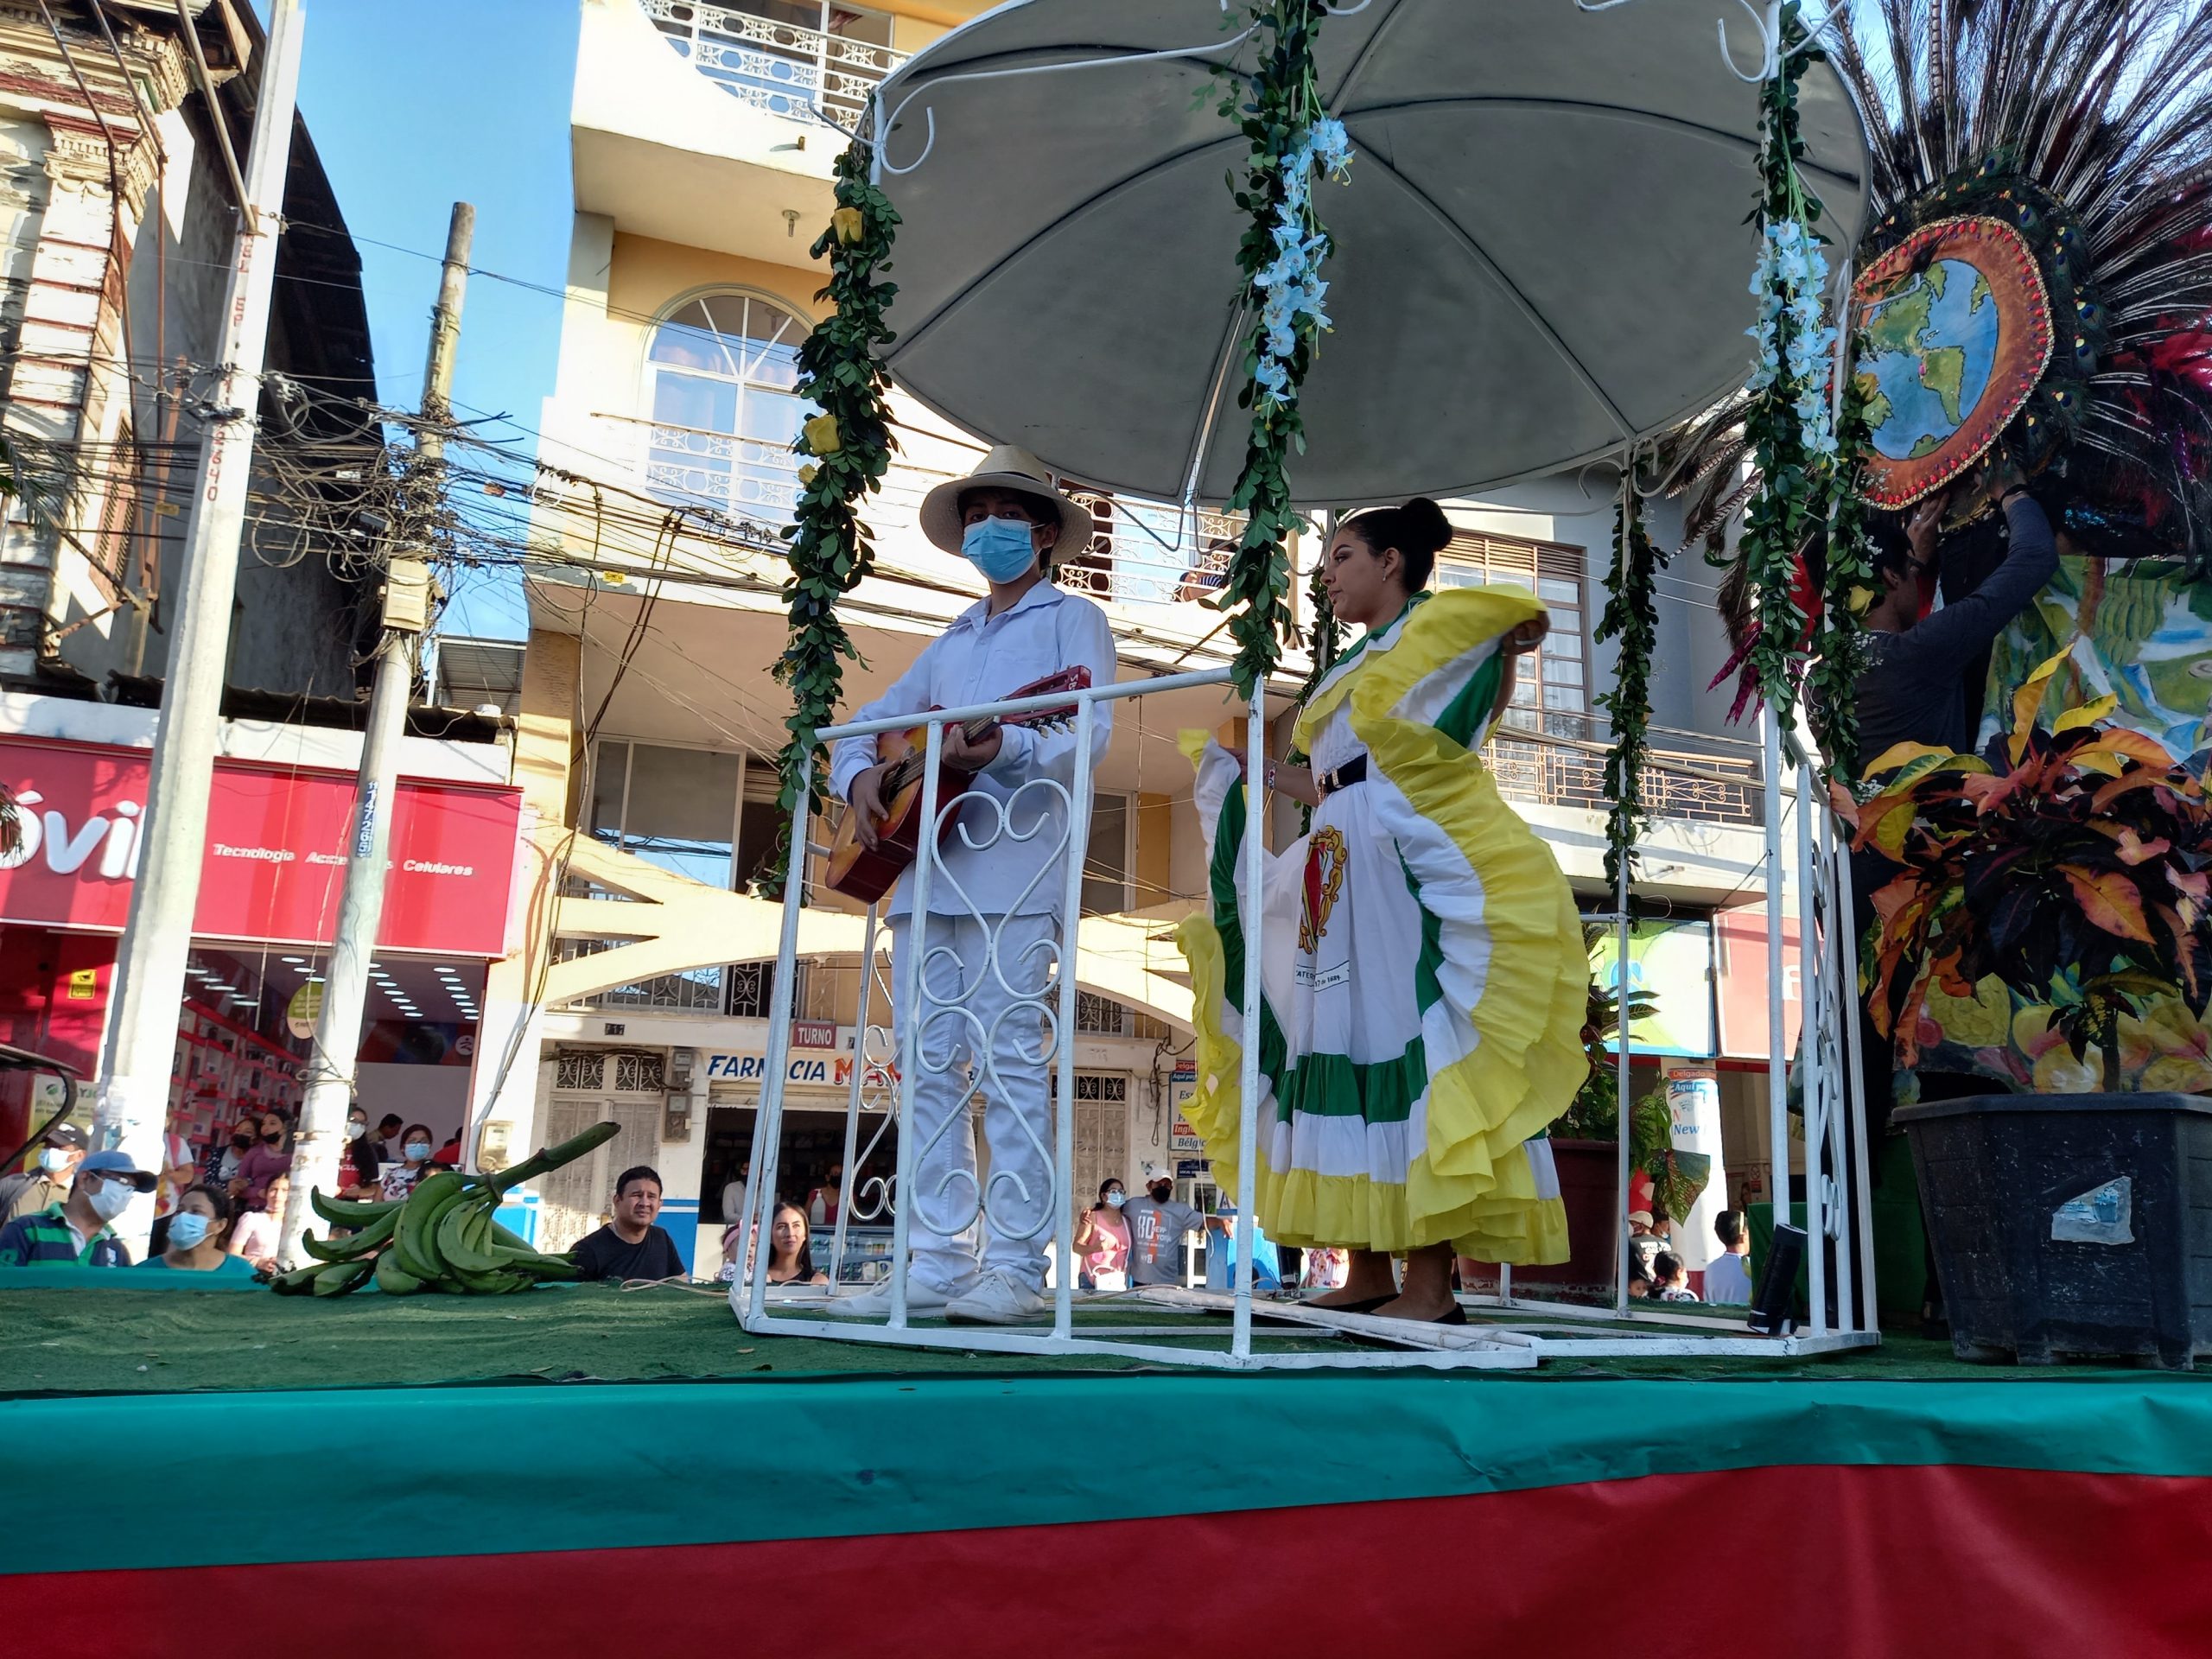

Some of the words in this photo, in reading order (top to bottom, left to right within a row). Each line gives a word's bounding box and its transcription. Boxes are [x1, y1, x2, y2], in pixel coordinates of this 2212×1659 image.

[403, 860, 474, 877] Celulares
[798, 1027, 832, 1046] TURNO
[1674, 1124, 1700, 1135] New
[1178, 1137, 1206, 1148] Bélgic
